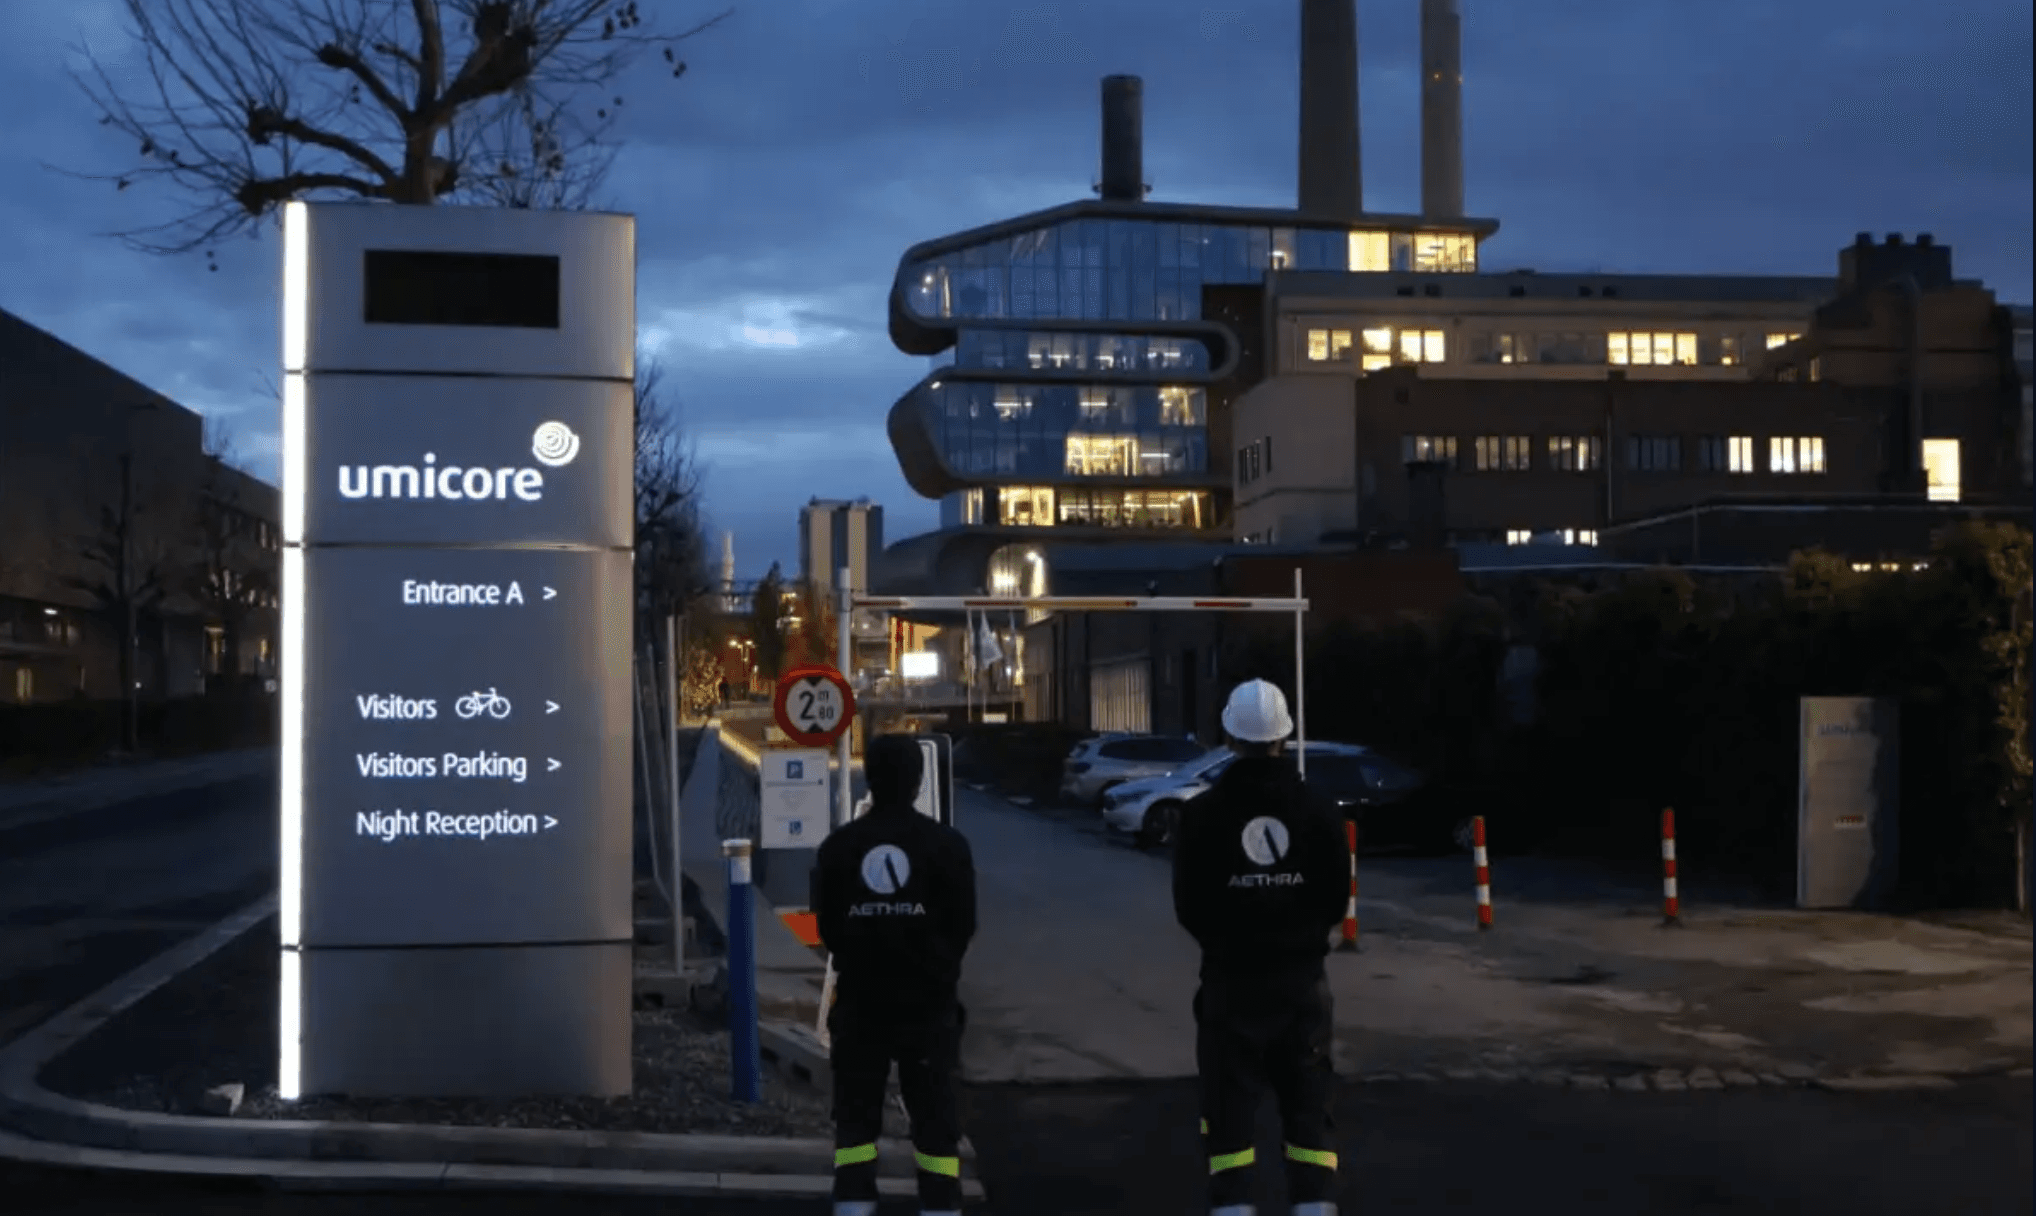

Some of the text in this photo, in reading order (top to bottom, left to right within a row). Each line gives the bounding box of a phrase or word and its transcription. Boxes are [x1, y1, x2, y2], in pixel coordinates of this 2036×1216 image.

[338, 452, 544, 501] umicore
[403, 580, 524, 604] Entrance A
[356, 694, 437, 720] Visitors
[799, 690, 816, 720] 2
[818, 706, 834, 720] 80
[356, 750, 527, 782] Visitors Parking
[356, 809, 537, 842] Night Reception
[1228, 872, 1304, 887] AETHRA
[848, 902, 926, 916] AETHRA
